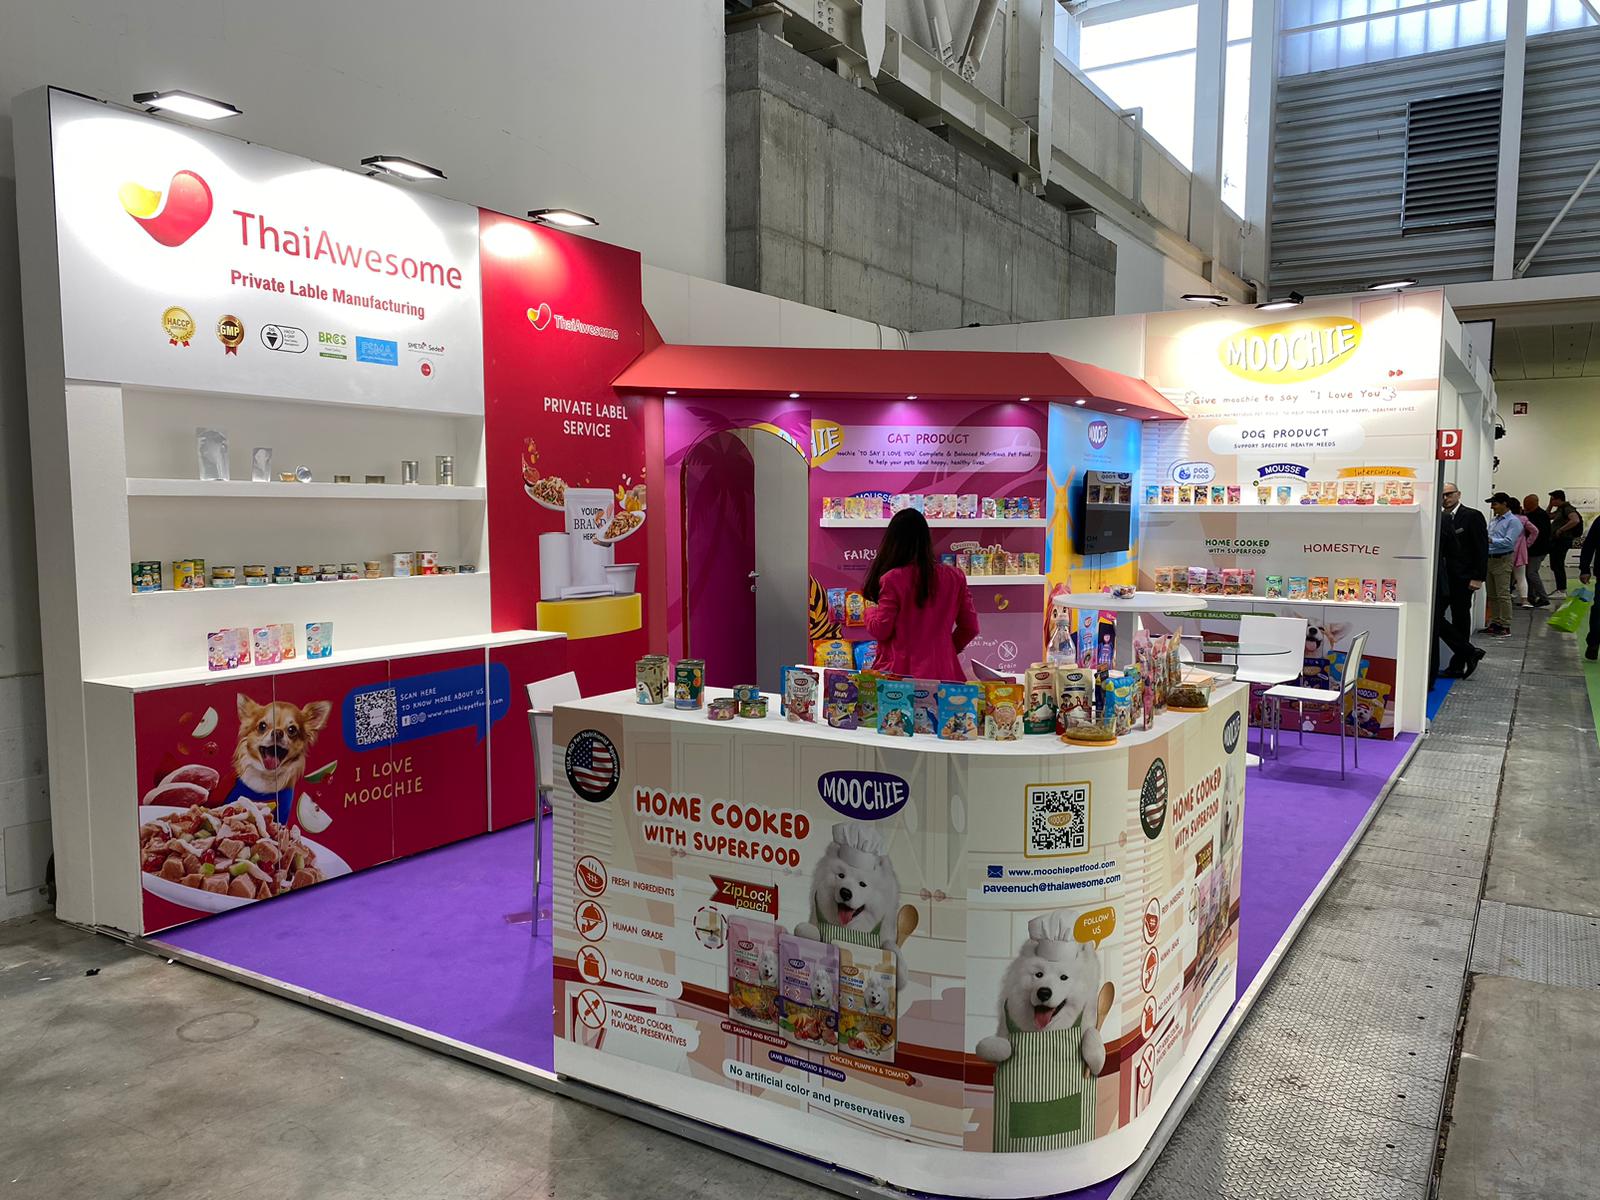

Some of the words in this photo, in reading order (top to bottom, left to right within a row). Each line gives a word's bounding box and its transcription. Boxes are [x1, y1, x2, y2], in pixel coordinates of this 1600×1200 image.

[233, 209, 462, 289] ThaiAwesome
[230, 269, 285, 294] Private
[290, 280, 328, 301] Lable
[333, 289, 425, 320] Manufacturing
[167, 317, 191, 328] HACCP
[220, 325, 240, 337] GMP
[554, 314, 619, 340] ThaiAwesome
[1228, 324, 1357, 372] MOOCHIE
[544, 397, 592, 416] PRIVATE
[596, 403, 628, 420] LABEL
[1193, 396, 1216, 405] Give
[1264, 394, 1274, 402] to
[1280, 394, 1298, 404] say
[1329, 391, 1353, 399] Love
[563, 420, 611, 438] SERVICE
[887, 433, 911, 444] CAT
[916, 433, 970, 444] PRODUCT
[1241, 430, 1266, 440] DOG
[1273, 428, 1329, 439] PRODUCT
[1441, 431, 1458, 448] D
[1265, 465, 1301, 476] MOUSSE
[1205, 539, 1231, 547] HOME
[1234, 539, 1270, 548] COOKED
[1303, 543, 1380, 556] HOMESTYLE
[844, 548, 877, 561] FAIRY
[400, 691, 418, 701] SCAN
[420, 687, 437, 698] HERE
[401, 704, 411, 712] TO
[413, 699, 432, 709] KNOW
[434, 694, 452, 704] MORE
[454, 690, 474, 701] ABOUT
[475, 687, 484, 695] US
[355, 767, 361, 782] I
[372, 756, 414, 778] LOVE
[344, 776, 424, 808] MOOCHIE
[823, 777, 905, 811] MOOCHIE
[1172, 787, 1194, 826] HOME
[1196, 766, 1222, 806] COOKED
[636, 790, 701, 823] HOME
[711, 803, 810, 840] COOKED
[1174, 826, 1190, 851] WITH
[1190, 798, 1220, 837] SUPERFOOD
[644, 825, 687, 846] WITH
[694, 832, 800, 868] SUPERFOOD
[1008, 860, 1116, 877] www.moochiepetfood.com
[611, 876, 630, 887] FRESH
[632, 880, 675, 897] INGREDIENTS
[722, 881, 773, 903] ZipLock
[983, 874, 1121, 894] paveenuch@thaiawesome.com
[736, 897, 769, 913] pouch
[1083, 913, 1109, 927] FOLLOW
[612, 922, 638, 935] HUMAN
[641, 928, 664, 941] GRADE
[1092, 927, 1102, 936] US
[611, 968, 622, 977] NO
[624, 971, 644, 983] FLOUR
[646, 977, 669, 989] ADDED
[611, 1009, 622, 1019] NO
[624, 1012, 646, 1024] ADDED
[646, 1018, 674, 1034] COLORS,
[611, 1019, 640, 1036] FLAVORS,
[640, 1026, 687, 1047] PRESERVATIVES
[733, 1025, 752, 1036] SALMON
[753, 1030, 764, 1039] AND
[764, 1034, 787, 1047] RICEBERRY
[784, 1056, 799, 1067] SWEET
[800, 1060, 818, 1072] POTATO
[819, 1065, 824, 1073] &
[824, 1067, 844, 1079] SPINACH
[854, 1060, 878, 1073] PUMPKIN
[885, 1068, 909, 1080] TOMATO
[729, 1063, 742, 1077] No
[745, 1069, 783, 1089] artificial
[785, 1081, 810, 1097] color
[812, 1088, 831, 1103] and
[833, 1097, 905, 1124] preservatives
